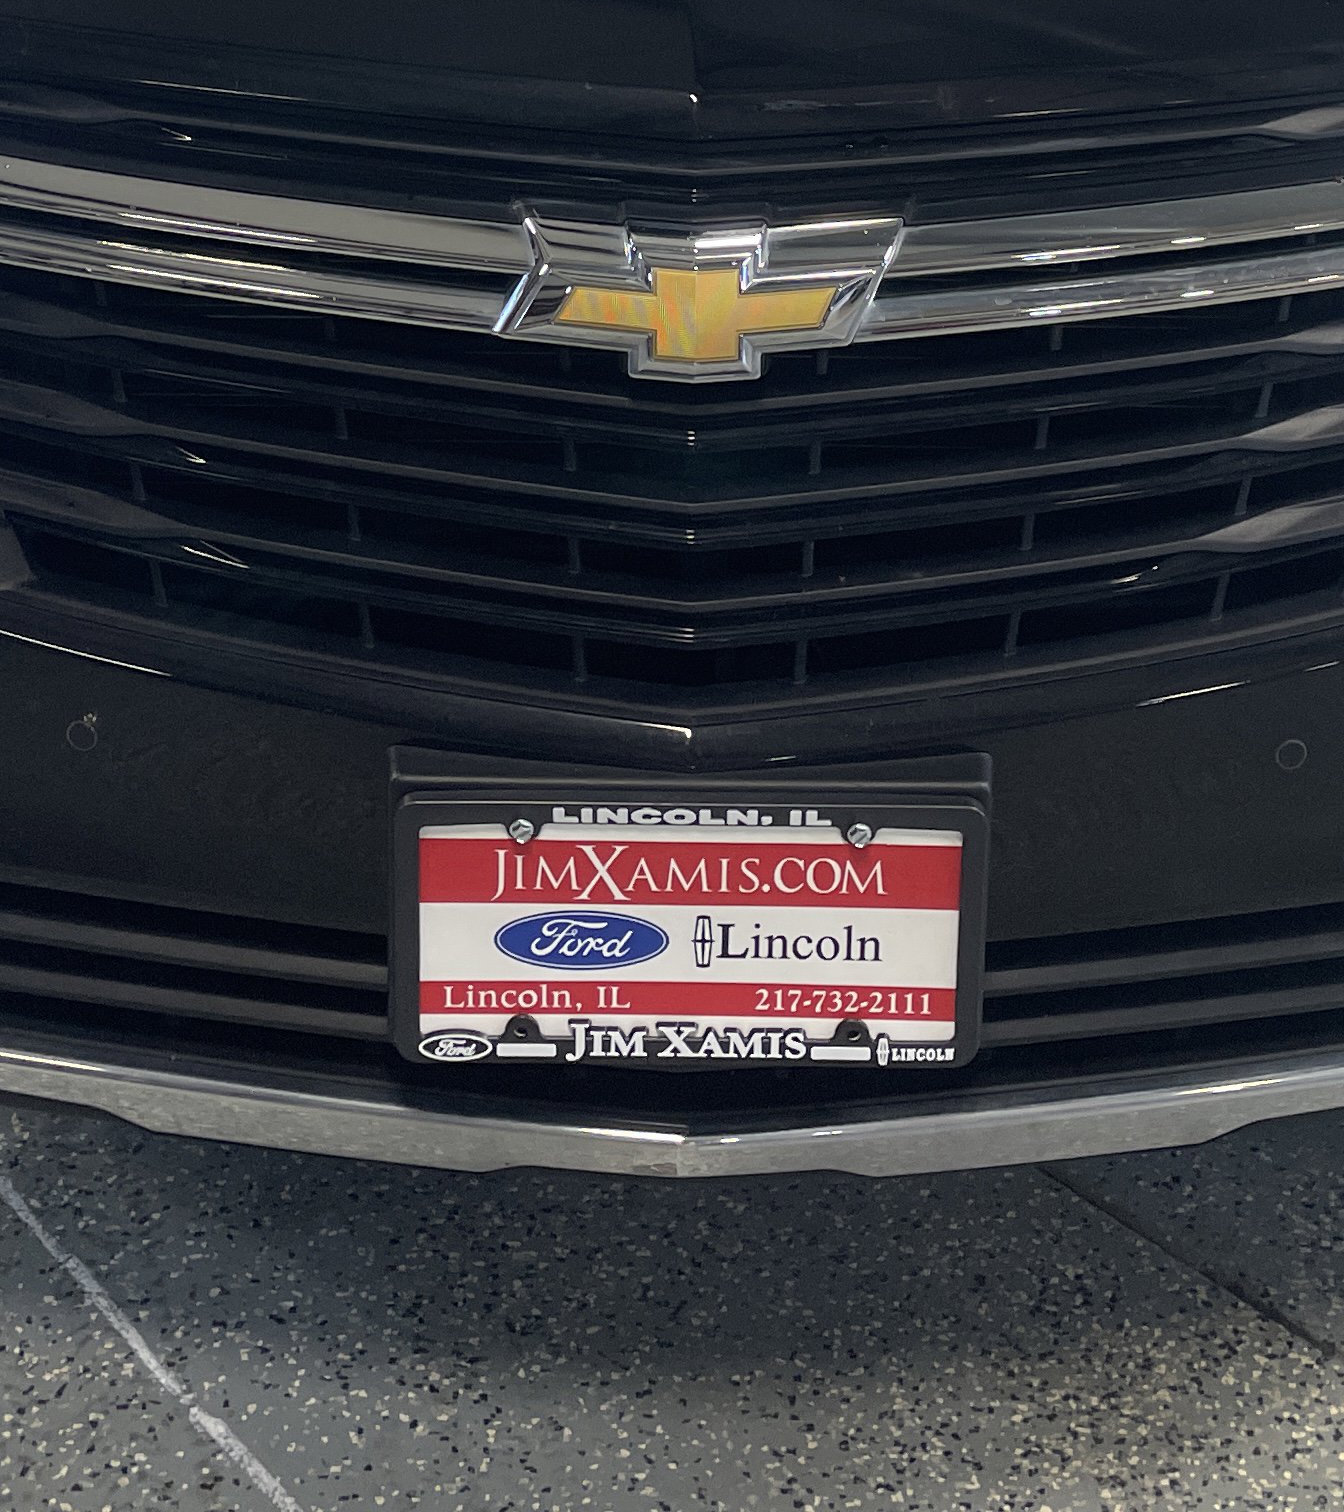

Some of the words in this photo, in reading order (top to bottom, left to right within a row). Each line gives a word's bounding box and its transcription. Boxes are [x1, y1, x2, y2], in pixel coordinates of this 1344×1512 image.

[552, 806, 774, 828] LINCOLN,
[788, 809, 833, 828] IL
[529, 919, 635, 959] Ford
[715, 922, 884, 963] Lincoln
[443, 984, 583, 1012] Lincoln,
[596, 986, 632, 1010] IL
[753, 988, 932, 1016] 217-732-2111
[434, 1038, 478, 1058] Ford
[565, 1022, 649, 1063] JIM
[657, 1025, 807, 1061] XAMIS
[891, 1046, 956, 1063] LINCOLN
